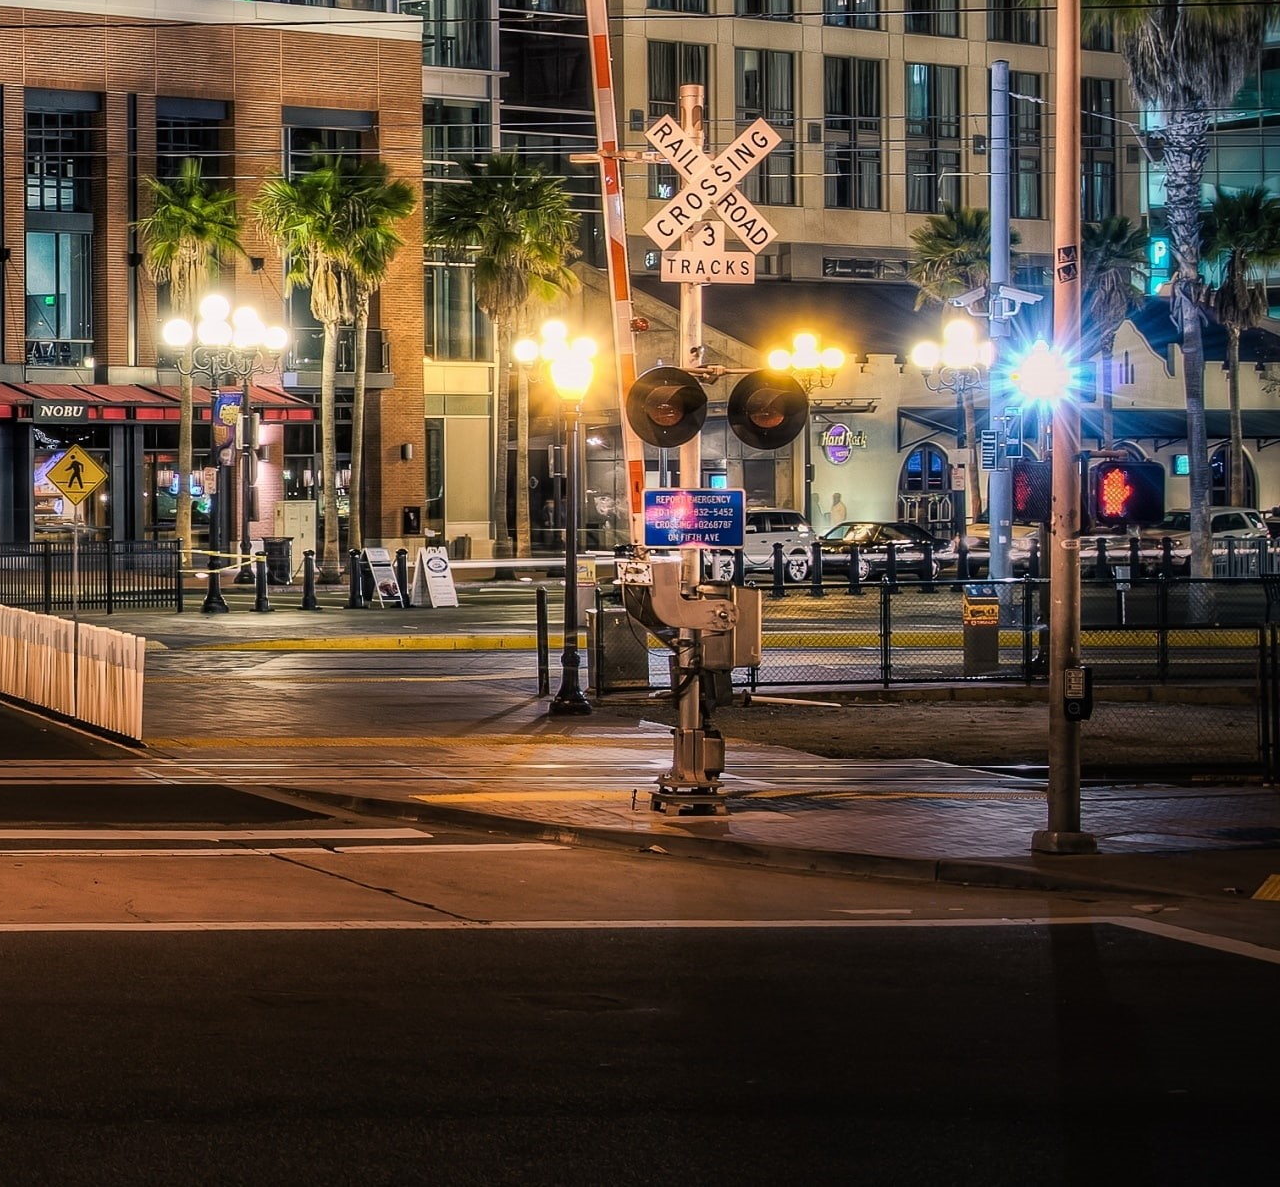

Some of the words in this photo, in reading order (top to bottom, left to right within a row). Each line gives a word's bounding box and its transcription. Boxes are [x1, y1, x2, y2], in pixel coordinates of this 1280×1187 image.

[653, 122, 698, 175] RAIL
[718, 193, 769, 245] ROAD
[657, 131, 769, 237] CROSSING
[703, 226, 715, 247] 3
[1154, 241, 1167, 264] P
[667, 258, 750, 275] TRACKS
[40, 405, 84, 417] NOBU
[821, 429, 845, 446] Hard
[846, 431, 868, 448] Rock
[690, 495, 732, 504] EMERGENCY
[655, 520, 691, 529] CROSSING
[668, 533, 679, 542] ON
[680, 533, 702, 542] FIFTH
[704, 533, 720, 542] AVE
